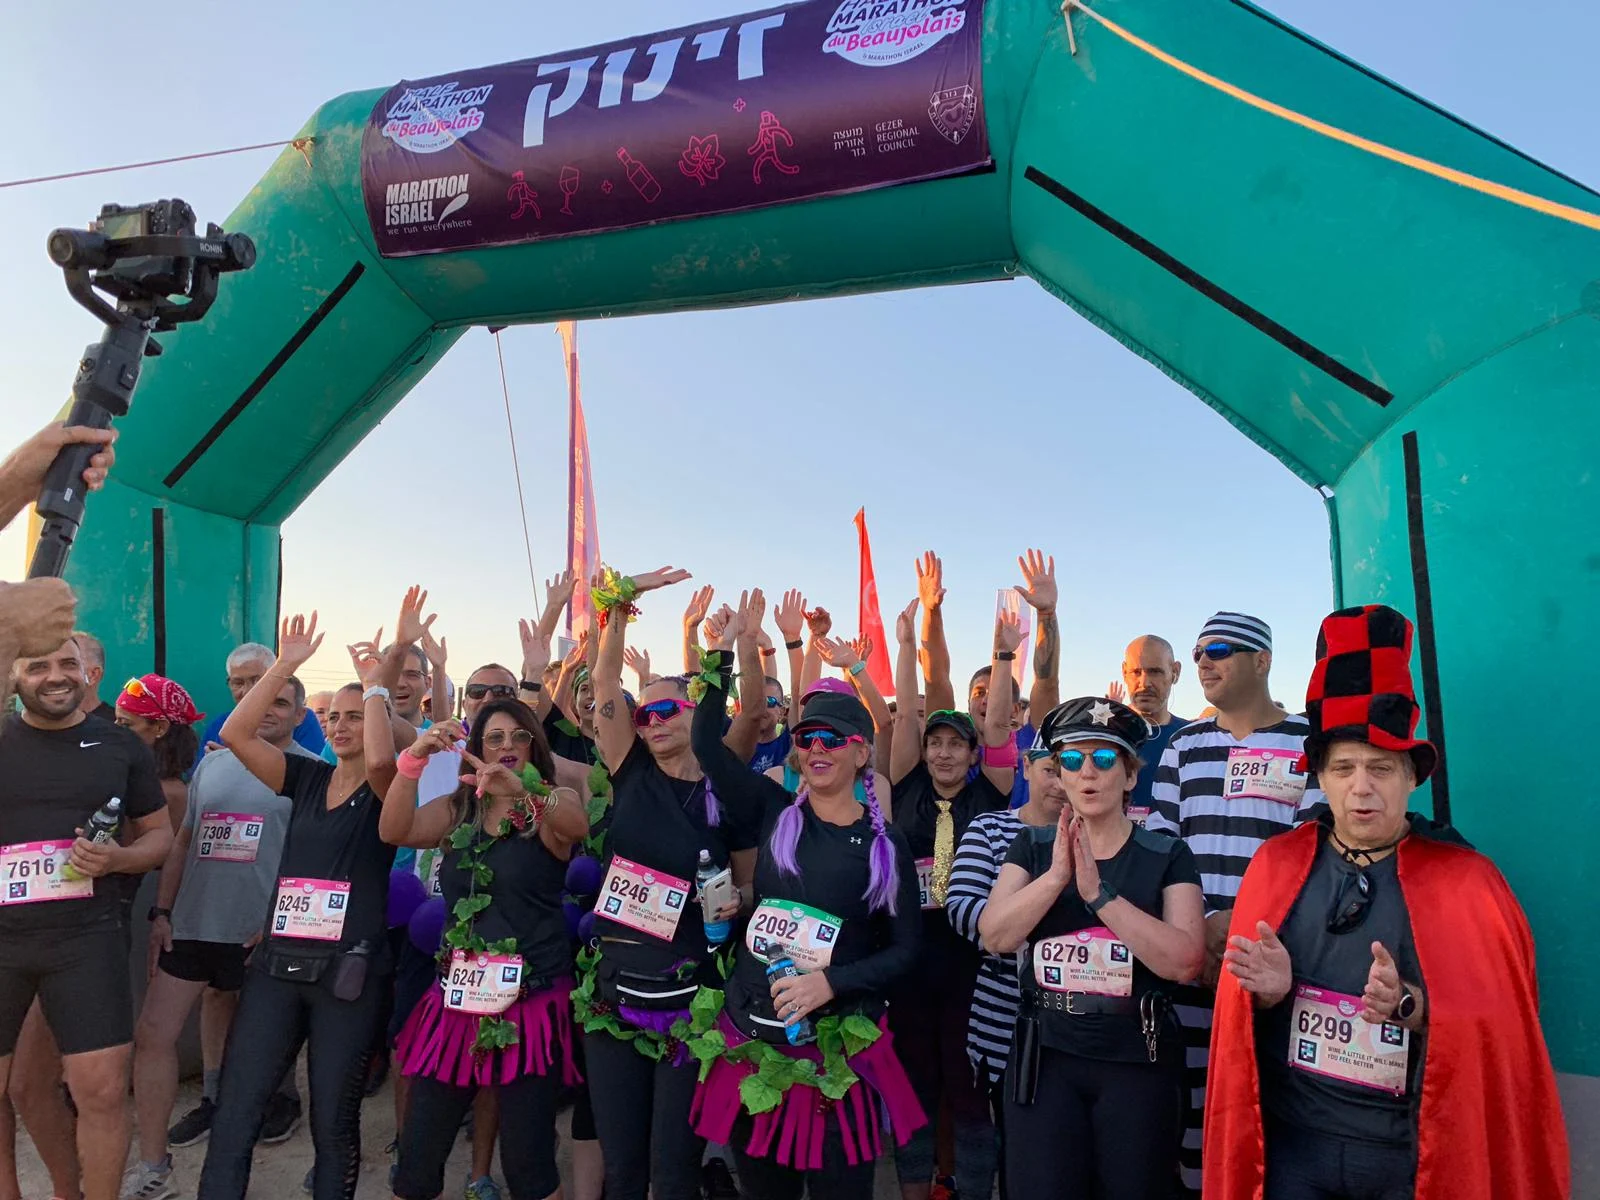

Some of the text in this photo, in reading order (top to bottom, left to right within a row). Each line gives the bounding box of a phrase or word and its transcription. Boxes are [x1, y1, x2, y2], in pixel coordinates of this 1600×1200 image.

[827, 10, 963, 52] du Beaujolais
[868, 51, 903, 61] MARATHON
[523, 12, 786, 148] זינוק
[391, 87, 490, 114] MARATHON
[833, 127, 863, 140] מועצה
[875, 119, 903, 132] GEZER
[877, 126, 920, 142] REGIONAL
[834, 137, 864, 150] אזורית
[850, 147, 866, 157] גזר
[878, 138, 915, 153] COUNCIL
[386, 173, 469, 205] MARATHON
[385, 201, 435, 226] ISRAEL
[387, 219, 473, 235] we run everywhere
[199, 242, 223, 254] RONIN
[1231, 762, 1269, 776] 6281
[203, 826, 231, 839] 7308
[7, 858, 55, 878] 7616
[610, 876, 649, 903] 6246
[278, 895, 310, 912] 6245
[754, 914, 798, 940] 2092
[1041, 942, 1089, 964] 6279
[452, 968, 485, 987] 6247
[1299, 1010, 1352, 1043] 6299
